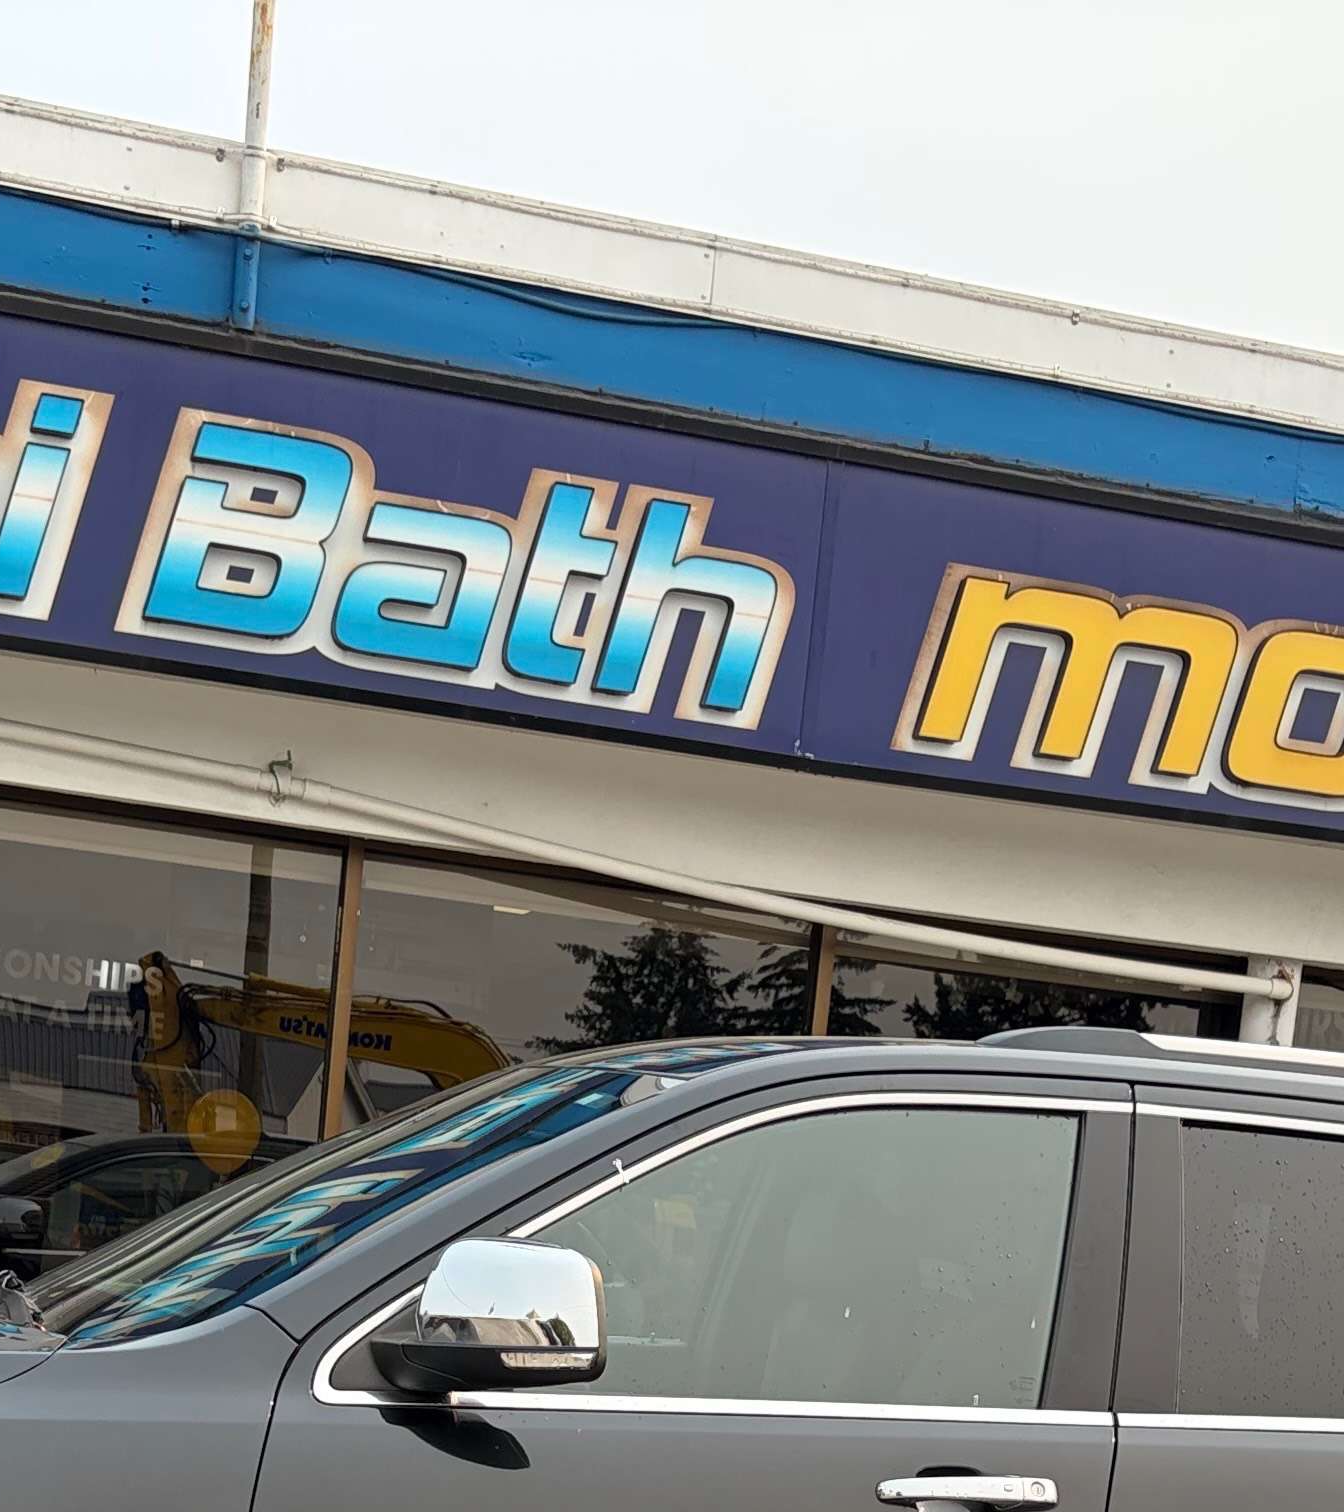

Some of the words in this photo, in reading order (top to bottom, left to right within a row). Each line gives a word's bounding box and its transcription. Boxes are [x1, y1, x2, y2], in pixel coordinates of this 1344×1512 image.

[114, 406, 796, 731] Bath
[47, 999, 72, 1027] A
[86, 1003, 166, 1041] TIME
